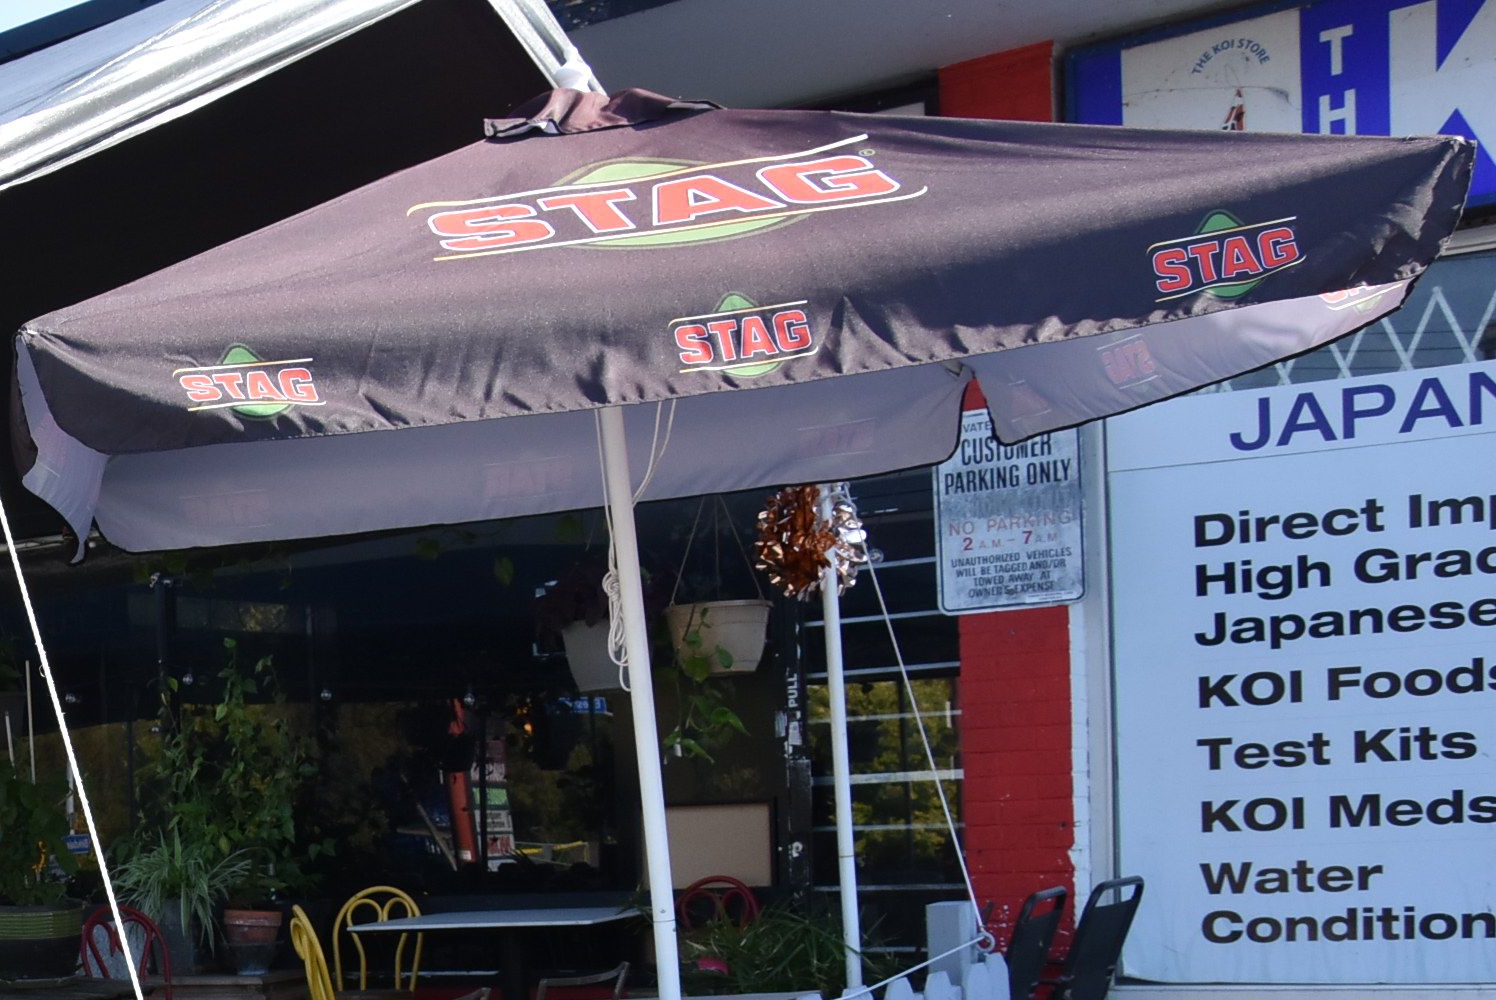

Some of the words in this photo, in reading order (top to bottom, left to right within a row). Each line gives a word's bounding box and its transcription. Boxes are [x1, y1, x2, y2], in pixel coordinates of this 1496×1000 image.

[1191, 51, 1213, 75] THE
[1211, 38, 1235, 55] KOI
[1236, 38, 1271, 65] STORE
[427, 155, 901, 251] STAG
[1152, 227, 1301, 294] STAG
[674, 309, 812, 365] STAG
[179, 367, 320, 403] STAG
[944, 464, 1020, 496] PARKING
[1026, 458, 1072, 486] ONLY
[949, 519, 975, 537] NO
[986, 508, 1072, 533] PARKING
[1194, 498, 1384, 548] Direct
[1409, 493, 1496, 530] Im
[951, 551, 1021, 568] UNAUTHORIZED
[1026, 547, 1073, 561] VEHICLES
[962, 536, 973, 551] 2
[1022, 530, 1033, 545] 7
[956, 565, 978, 578] WILL
[980, 564, 992, 576] BE
[994, 561, 1028, 575] TAGGED
[1029, 558, 1067, 571] AND/OR
[973, 573, 1005, 587] TOWED
[1008, 571, 1035, 583] AWAY
[1040, 570, 1052, 580] AT
[1014, 580, 1056, 594] EXPENSE
[1195, 555, 1332, 601] High
[1194, 597, 1496, 649] Japanese
[787, 672, 798, 708] PULL
[1198, 669, 1304, 709] KOI
[1196, 732, 1331, 771] Test
[1353, 727, 1478, 764] Kits
[1200, 796, 1305, 834] KOI
[1329, 789, 1496, 829] Meds
[1199, 860, 1384, 895] Water
[1201, 906, 1496, 944] Condition
